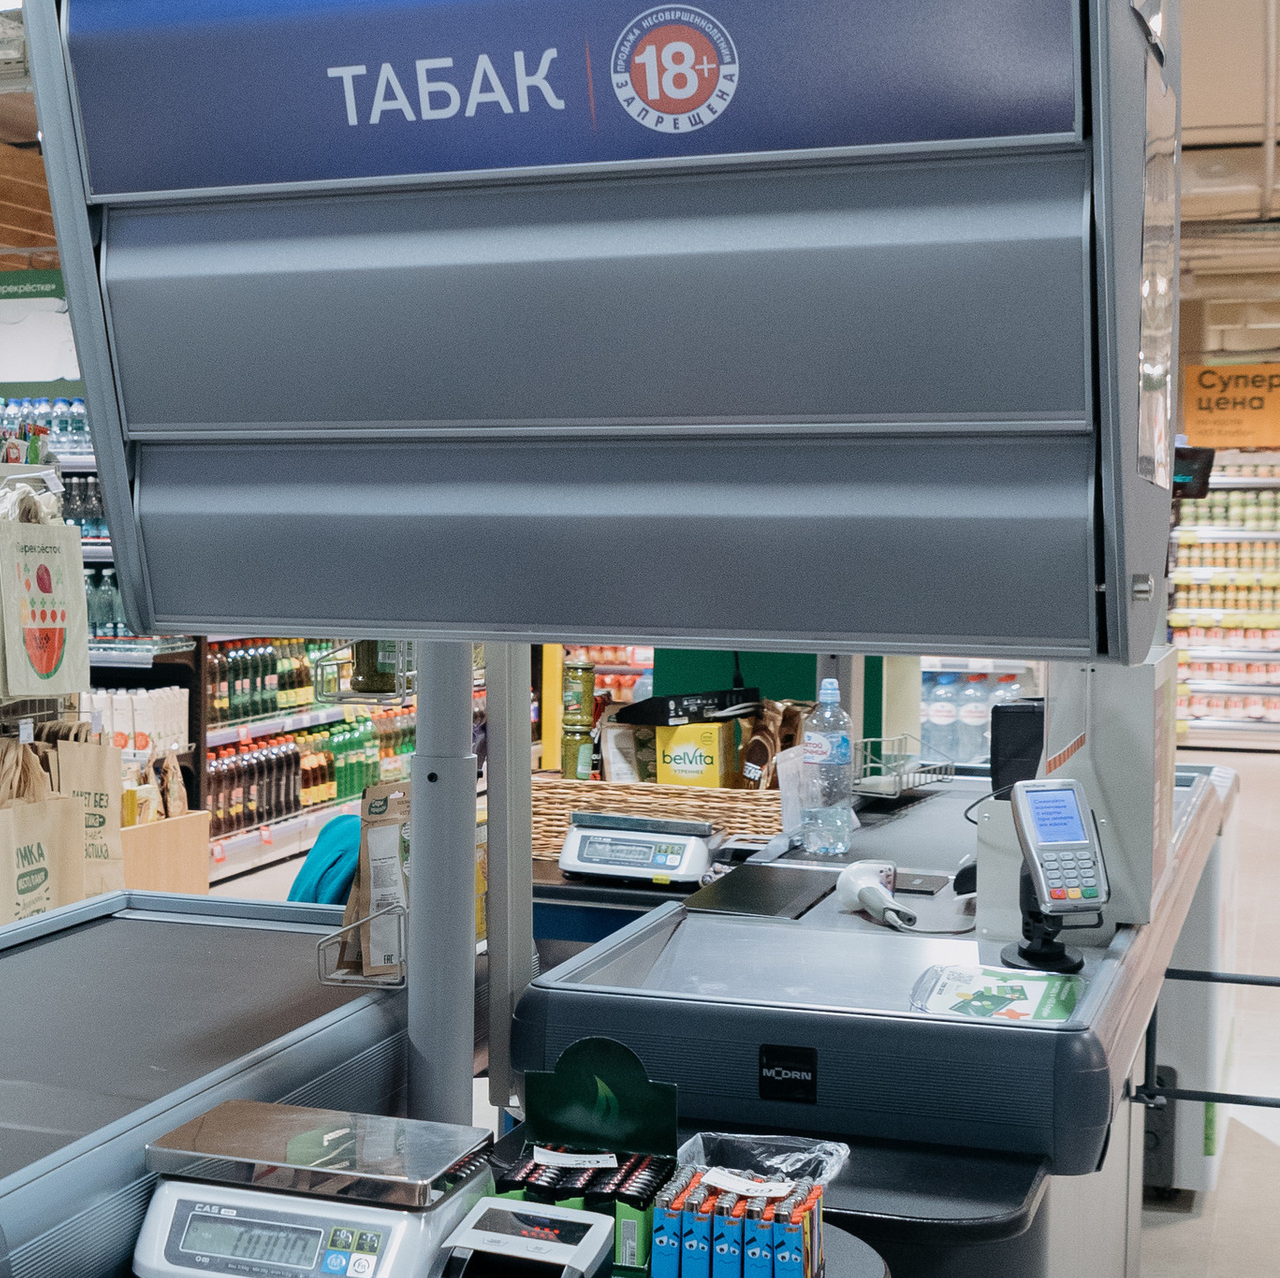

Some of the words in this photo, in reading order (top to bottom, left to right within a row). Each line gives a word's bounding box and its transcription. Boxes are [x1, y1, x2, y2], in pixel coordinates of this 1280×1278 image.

[617, 28, 641, 72] ПРОДАЖА
[641, 10, 732, 63] НЕСОВЕРШЕННОЛЕТНИМ
[327, 48, 565, 126] ТАБАК
[634, 41, 716, 101] 18+
[616, 72, 735, 130] ЗАПРЕЩЕНА
[1197, 395, 1265, 416] цена
[663, 747, 714, 766] belVita
[195, 1204, 219, 1213] CAS
